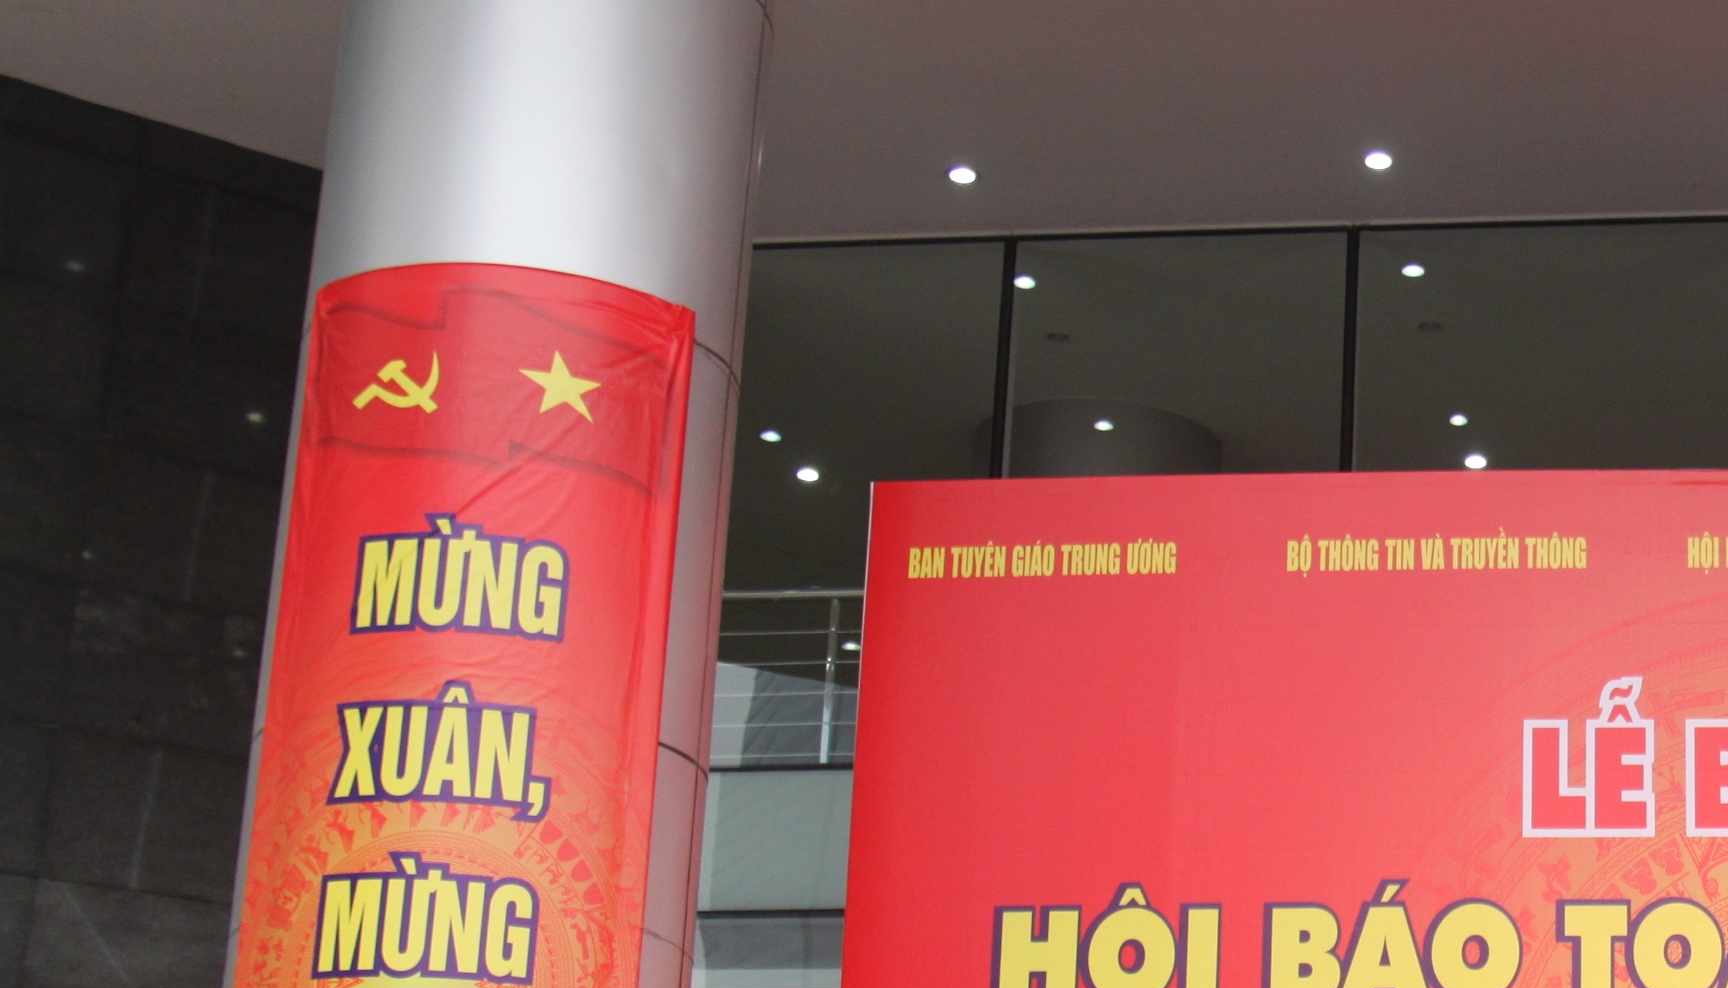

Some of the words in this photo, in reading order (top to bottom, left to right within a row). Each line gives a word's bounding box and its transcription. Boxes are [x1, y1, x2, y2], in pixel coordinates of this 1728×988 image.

[350, 512, 570, 643] MỪNG
[908, 547, 946, 579] BAN
[950, 540, 1007, 578] TUYÊN
[1011, 540, 1056, 577] GIÁO
[1061, 543, 1121, 576] TRUNG
[1126, 538, 1178, 575] ƯƠNG
[1286, 535, 1312, 578] BỘ
[1318, 534, 1380, 572] THÔNG
[1385, 538, 1416, 571] TIN
[1420, 533, 1446, 570] VÀ
[1450, 527, 1520, 570] TRUYỀN
[1525, 532, 1588, 570] THÔNG
[1687, 531, 1720, 575] HỘI
[325, 680, 553, 823] XUÂN,
[1522, 677, 1655, 838] LỄ
[311, 851, 540, 986] MỪNG
